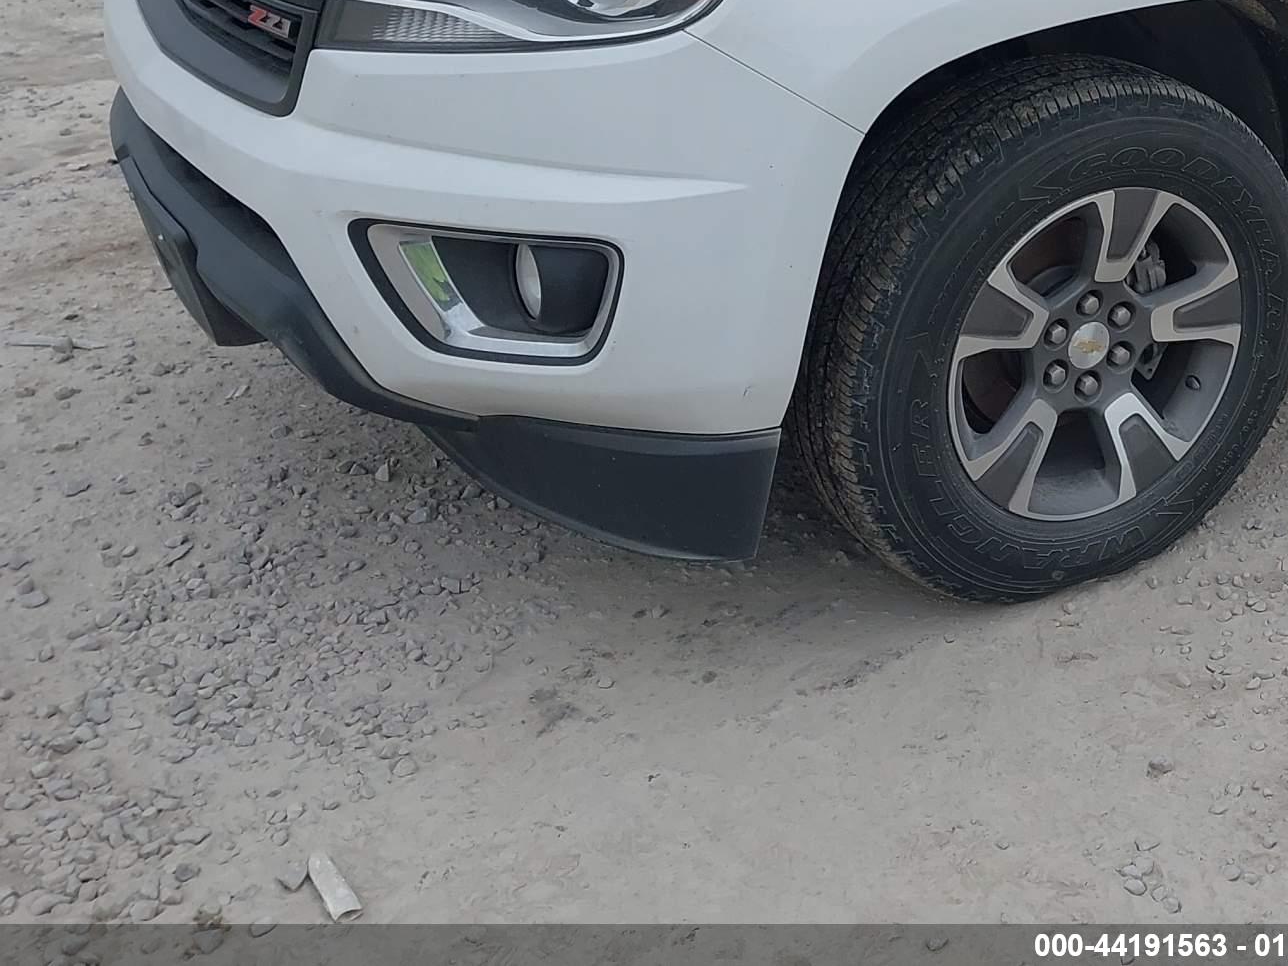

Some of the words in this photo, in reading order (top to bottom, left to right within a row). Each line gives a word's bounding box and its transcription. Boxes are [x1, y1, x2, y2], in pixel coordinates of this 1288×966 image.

[247, 4, 291, 39] Z71
[1068, 146, 1286, 332] GOODYEAR
[911, 398, 1147, 569] WRANGLER
